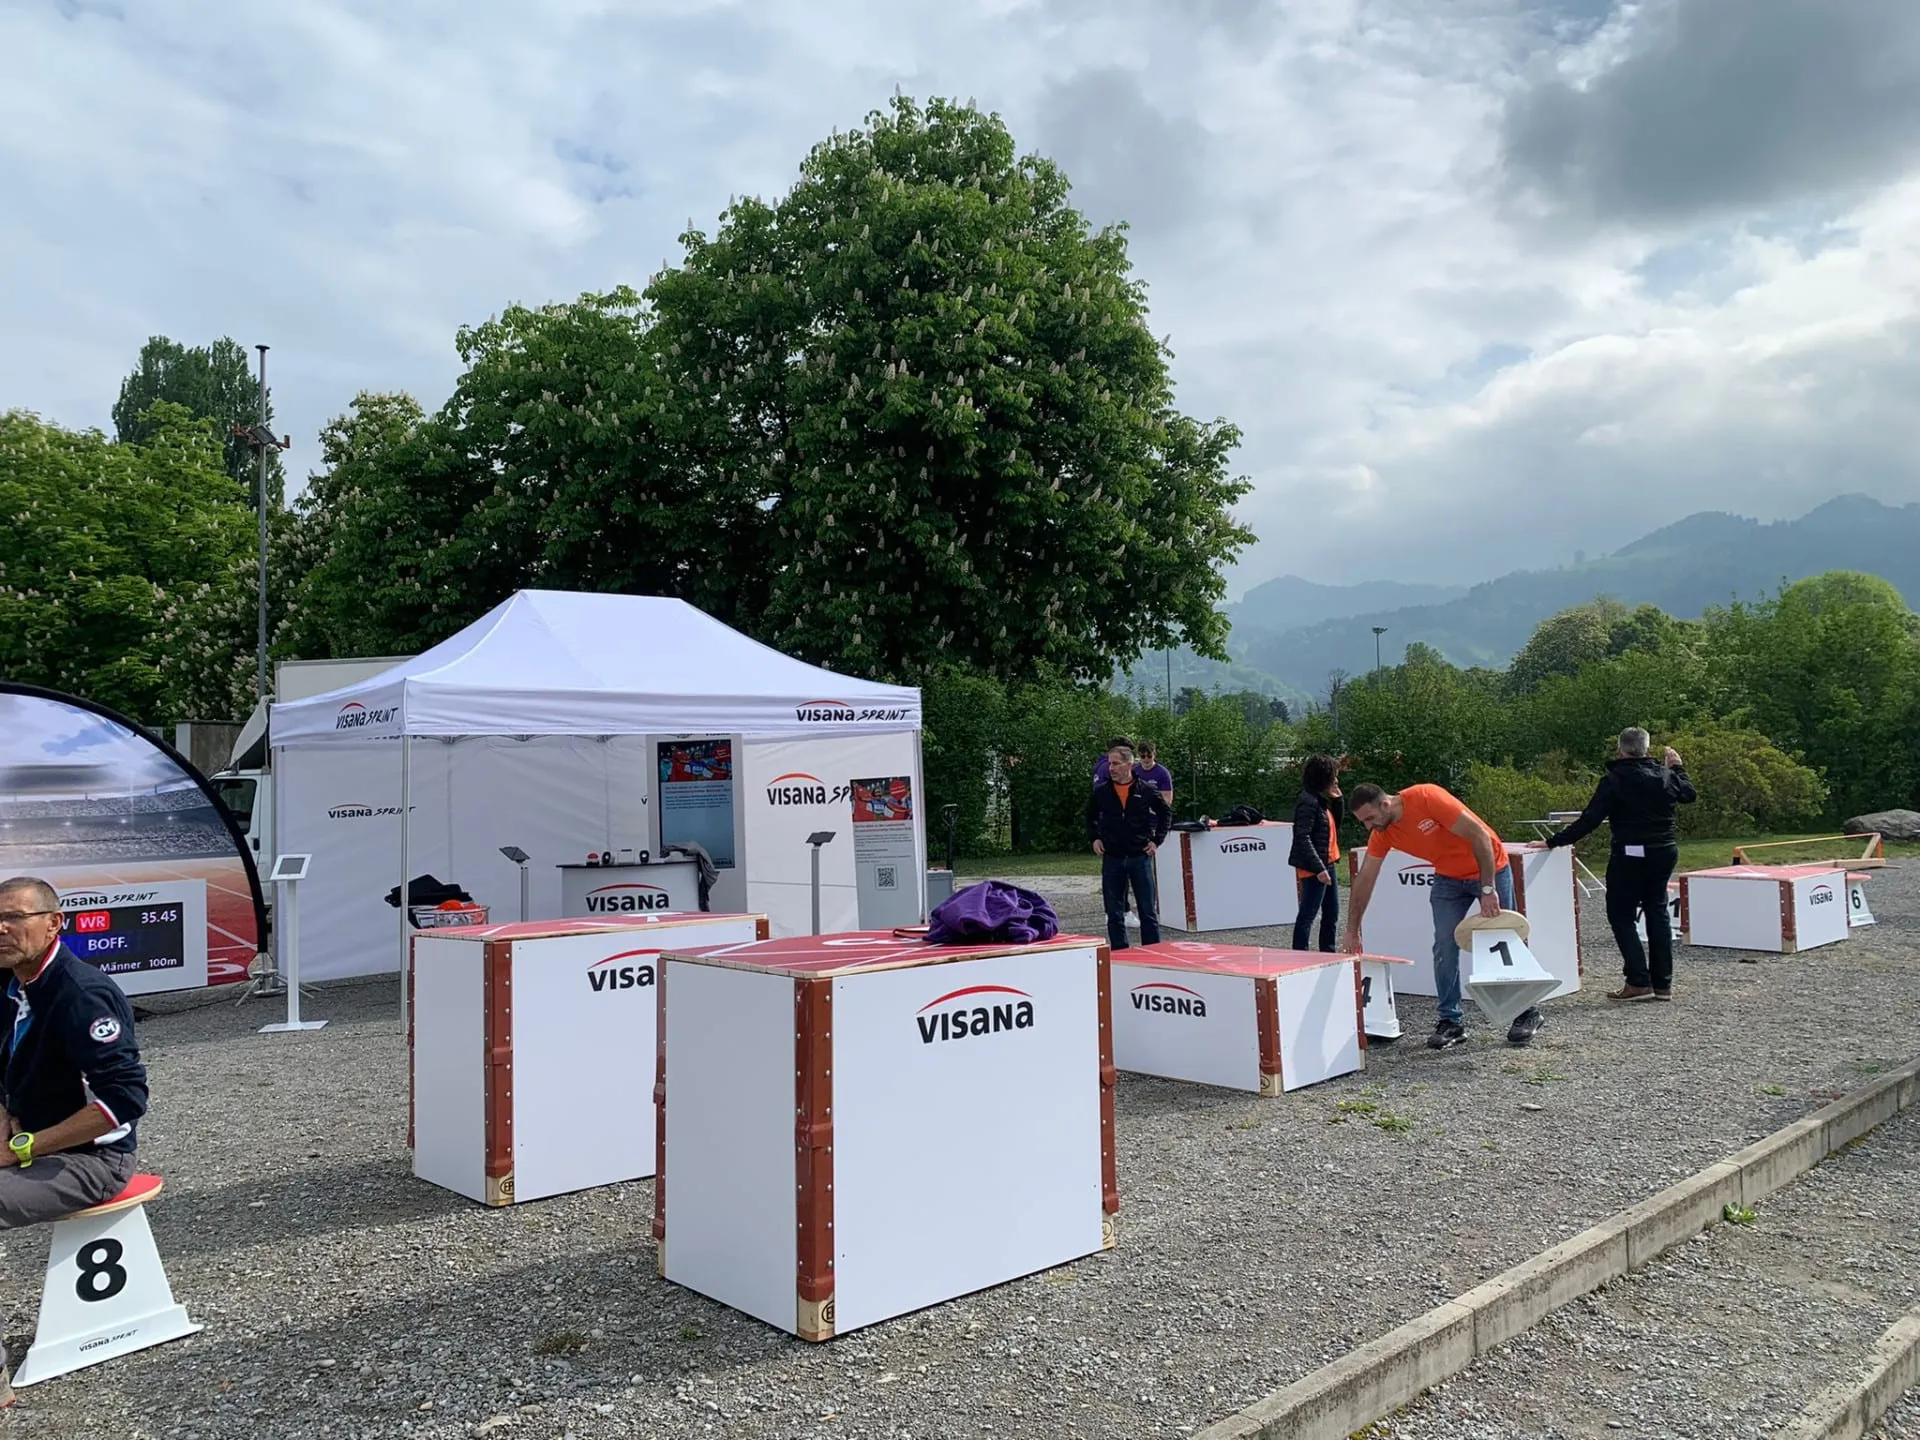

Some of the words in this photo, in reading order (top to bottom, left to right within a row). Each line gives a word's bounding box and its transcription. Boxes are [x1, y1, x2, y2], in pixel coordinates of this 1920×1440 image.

[366, 707, 399, 725] SPRINT
[857, 709, 913, 721] SPRINT
[109, 892, 159, 904] SPRINT
[1851, 889, 1861, 909] 6
[80, 916, 106, 929] WR
[141, 910, 177, 924] 35.45
[88, 937, 128, 951] BOFF.
[1489, 941, 1514, 966] 1
[100, 961, 141, 972] Männer
[149, 958, 177, 968] 100m
[75, 1237, 127, 1303] 8
